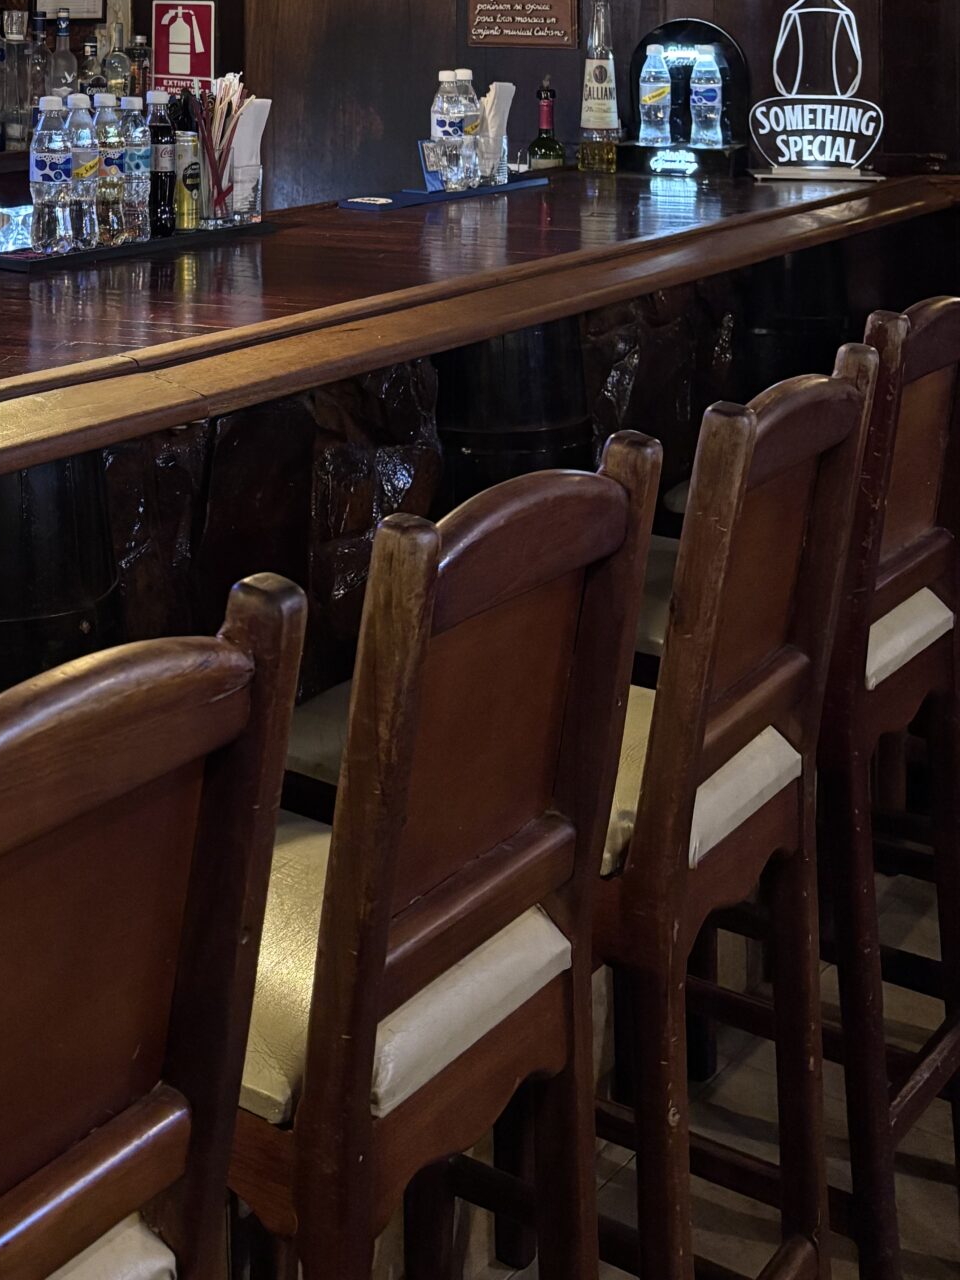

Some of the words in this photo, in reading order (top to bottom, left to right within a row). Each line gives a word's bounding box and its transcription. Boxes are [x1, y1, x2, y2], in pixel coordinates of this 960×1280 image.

[474, 15, 494, 25] para
[472, 26, 501, 39] conjunto
[503, 28, 533, 36] musical
[755, 104, 877, 136] SOMETHING
[775, 134, 857, 164] SPECIAL
